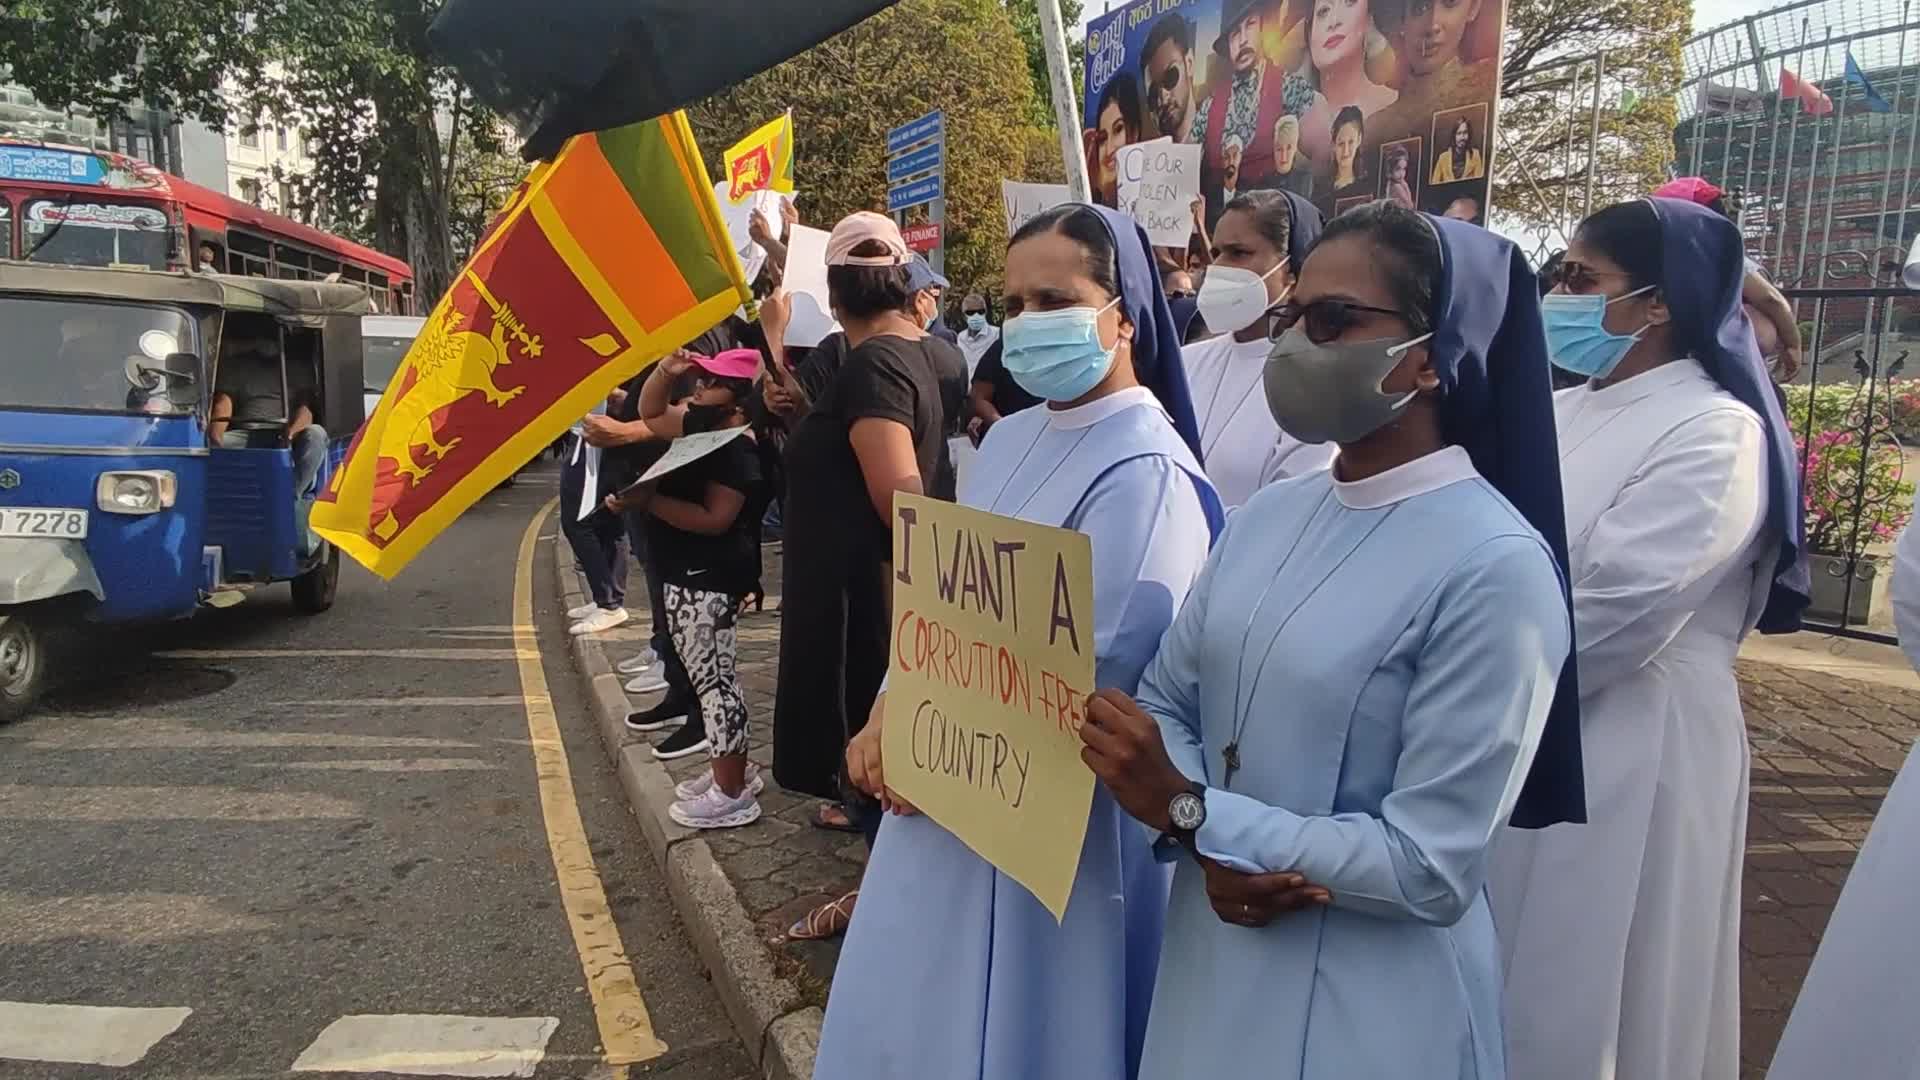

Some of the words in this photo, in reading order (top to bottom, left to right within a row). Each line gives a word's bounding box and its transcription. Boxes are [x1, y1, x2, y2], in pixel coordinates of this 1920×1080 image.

[1154, 152, 1183, 175] OUR
[1147, 210, 1182, 232] BACK
[15, 512, 82, 535] 7278
[896, 507, 917, 585] I
[932, 521, 1026, 633] WANT
[1049, 552, 1081, 656] A
[897, 610, 1032, 715] CORRUTION
[912, 700, 1031, 808] COUNTRY
